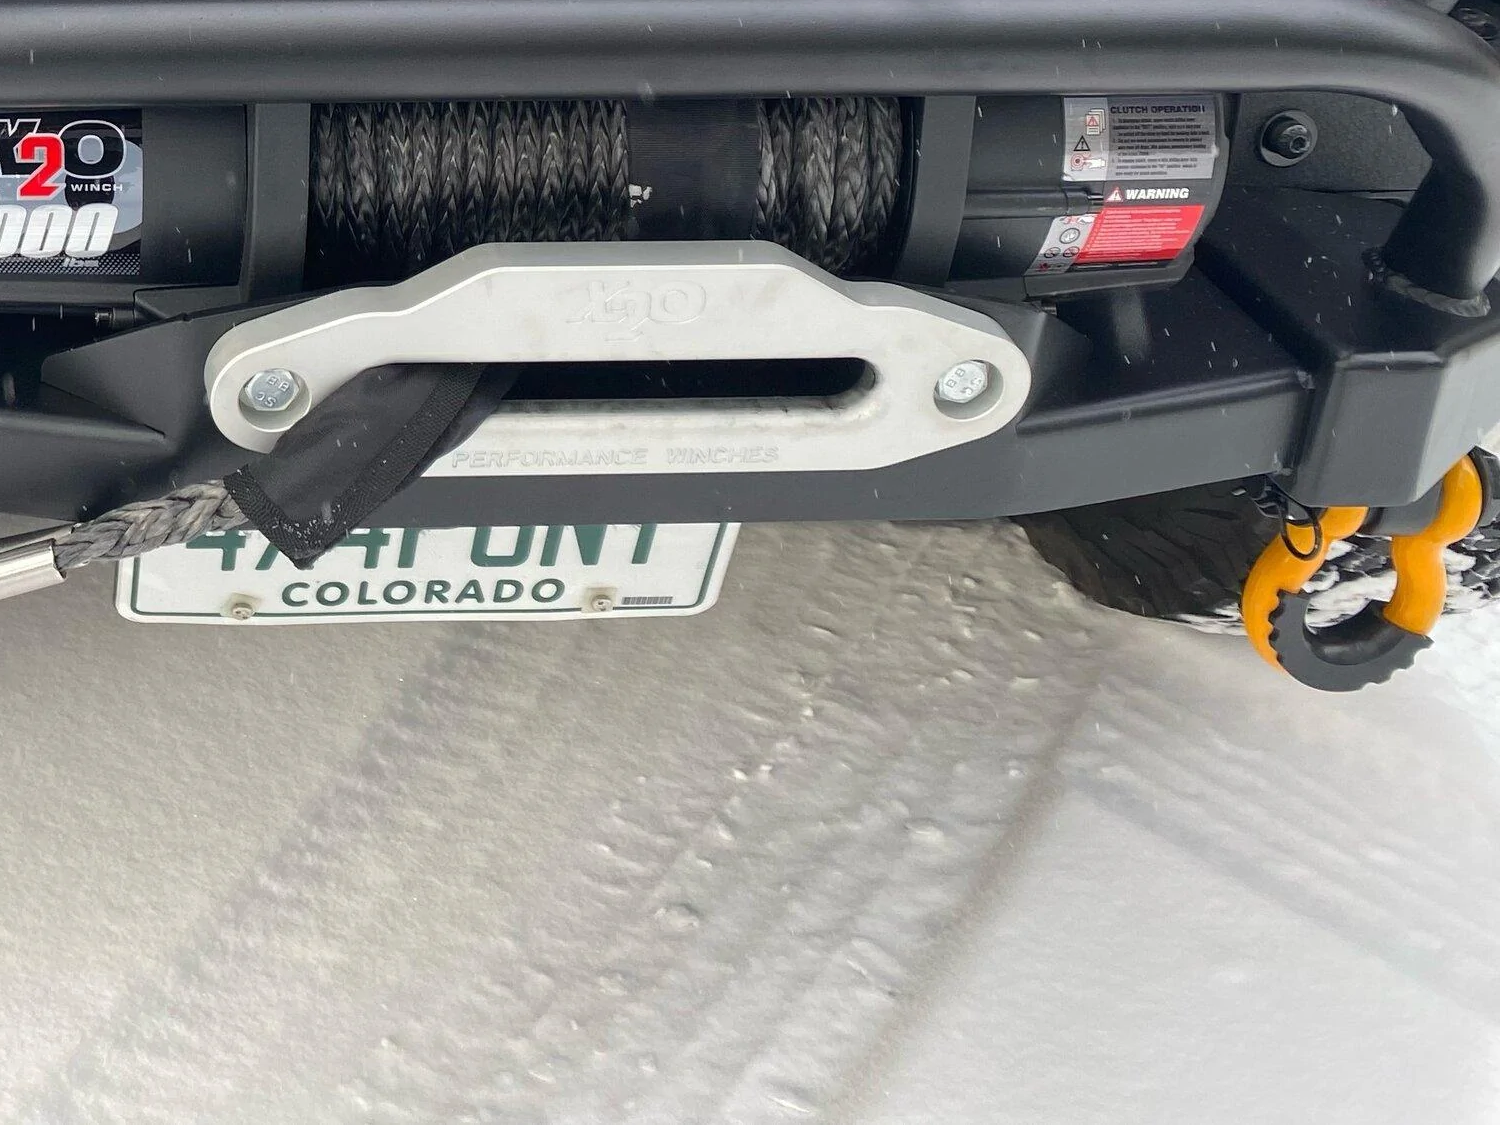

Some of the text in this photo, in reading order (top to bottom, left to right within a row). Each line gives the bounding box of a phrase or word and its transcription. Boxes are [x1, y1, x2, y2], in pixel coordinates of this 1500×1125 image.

[1110, 105, 1206, 114] CLUTCH OPERATION
[70, 183, 123, 192] WINCH
[1125, 187, 1190, 200] WARNING
[451, 446, 781, 469] PERFORMANCE WINCHES
[281, 578, 565, 607] COLORADO
